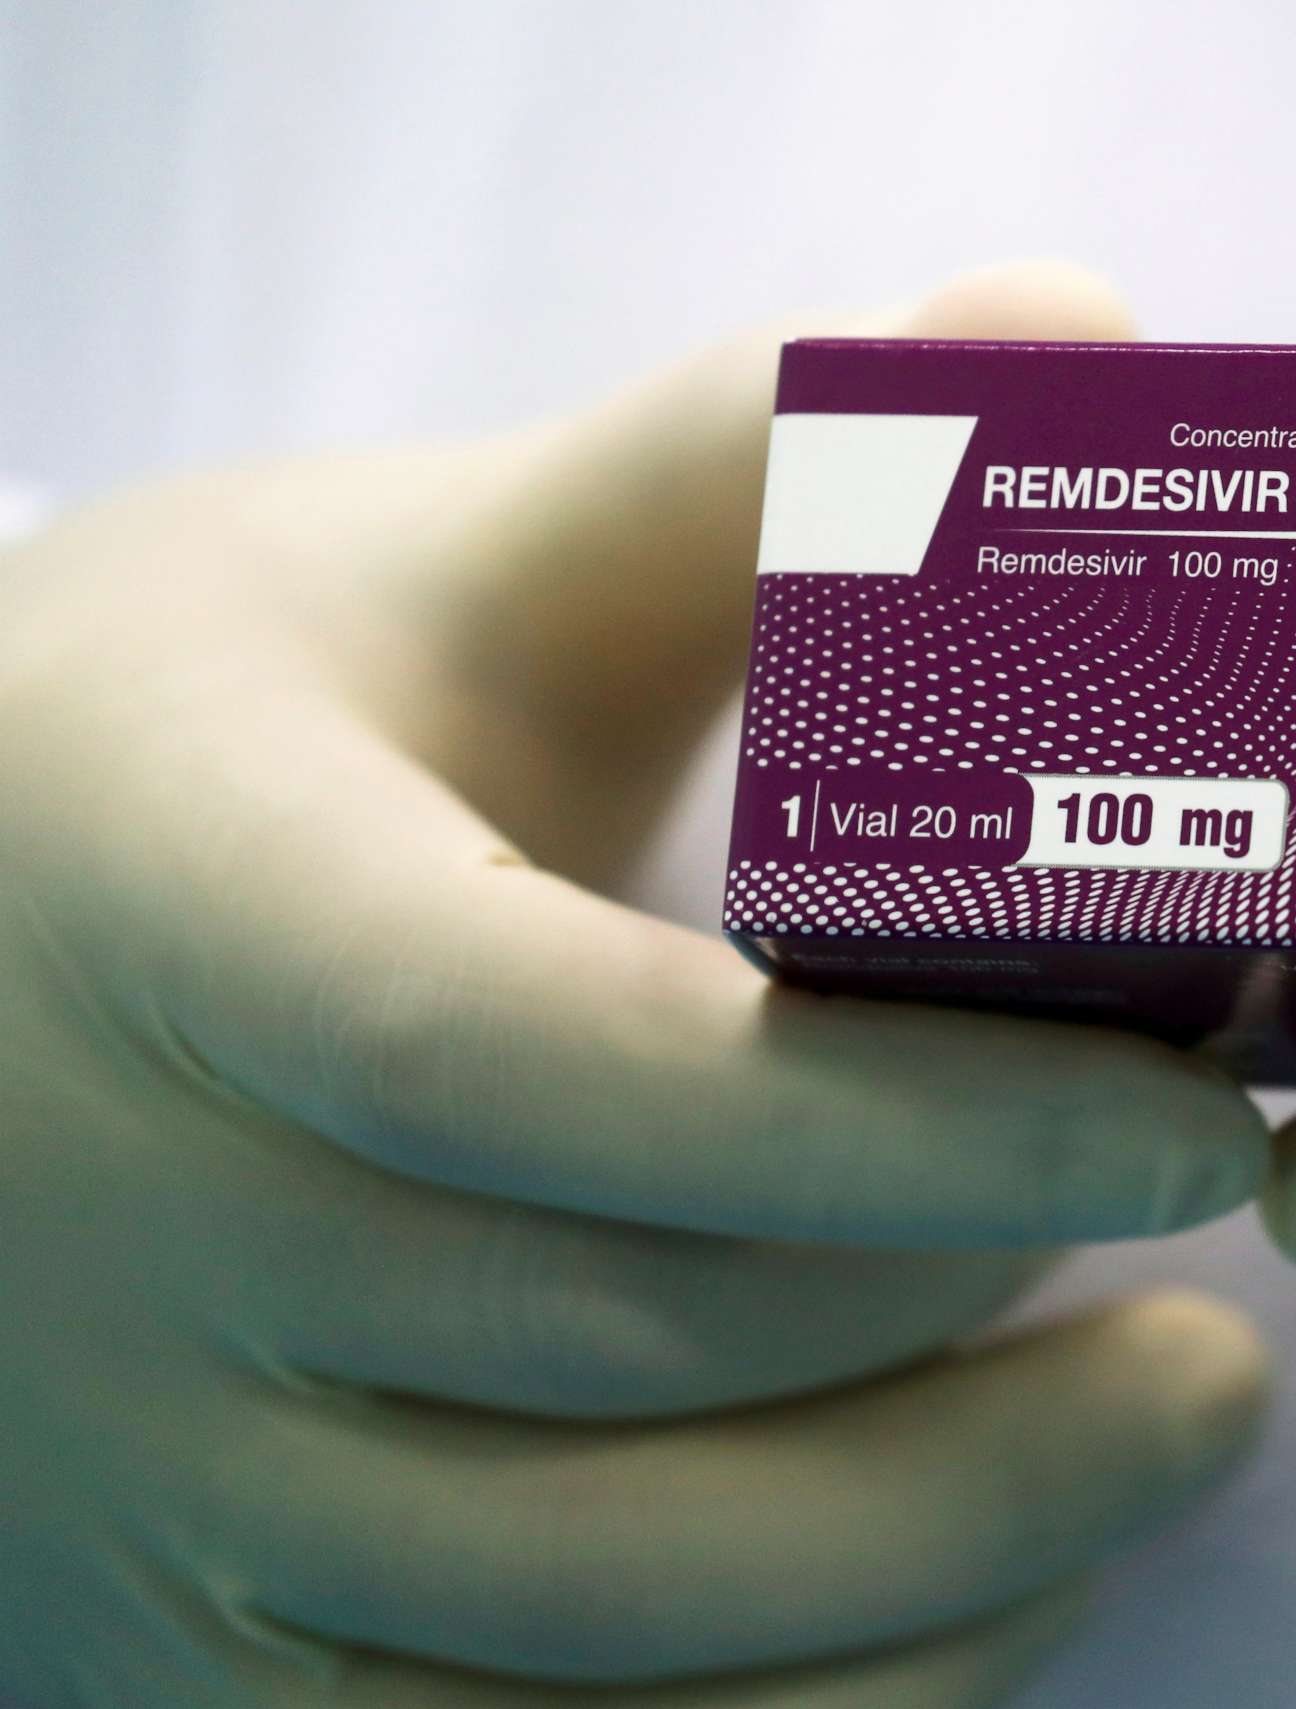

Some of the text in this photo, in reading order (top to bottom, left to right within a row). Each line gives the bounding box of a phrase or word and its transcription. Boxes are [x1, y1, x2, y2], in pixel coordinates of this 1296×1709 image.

[982, 465, 1290, 513] REMDESIVIR
[977, 546, 1279, 586] Remdesivir 100 mg
[781, 795, 1013, 839] 1 Vial 20 ml
[1057, 792, 1254, 858] 100 mg
